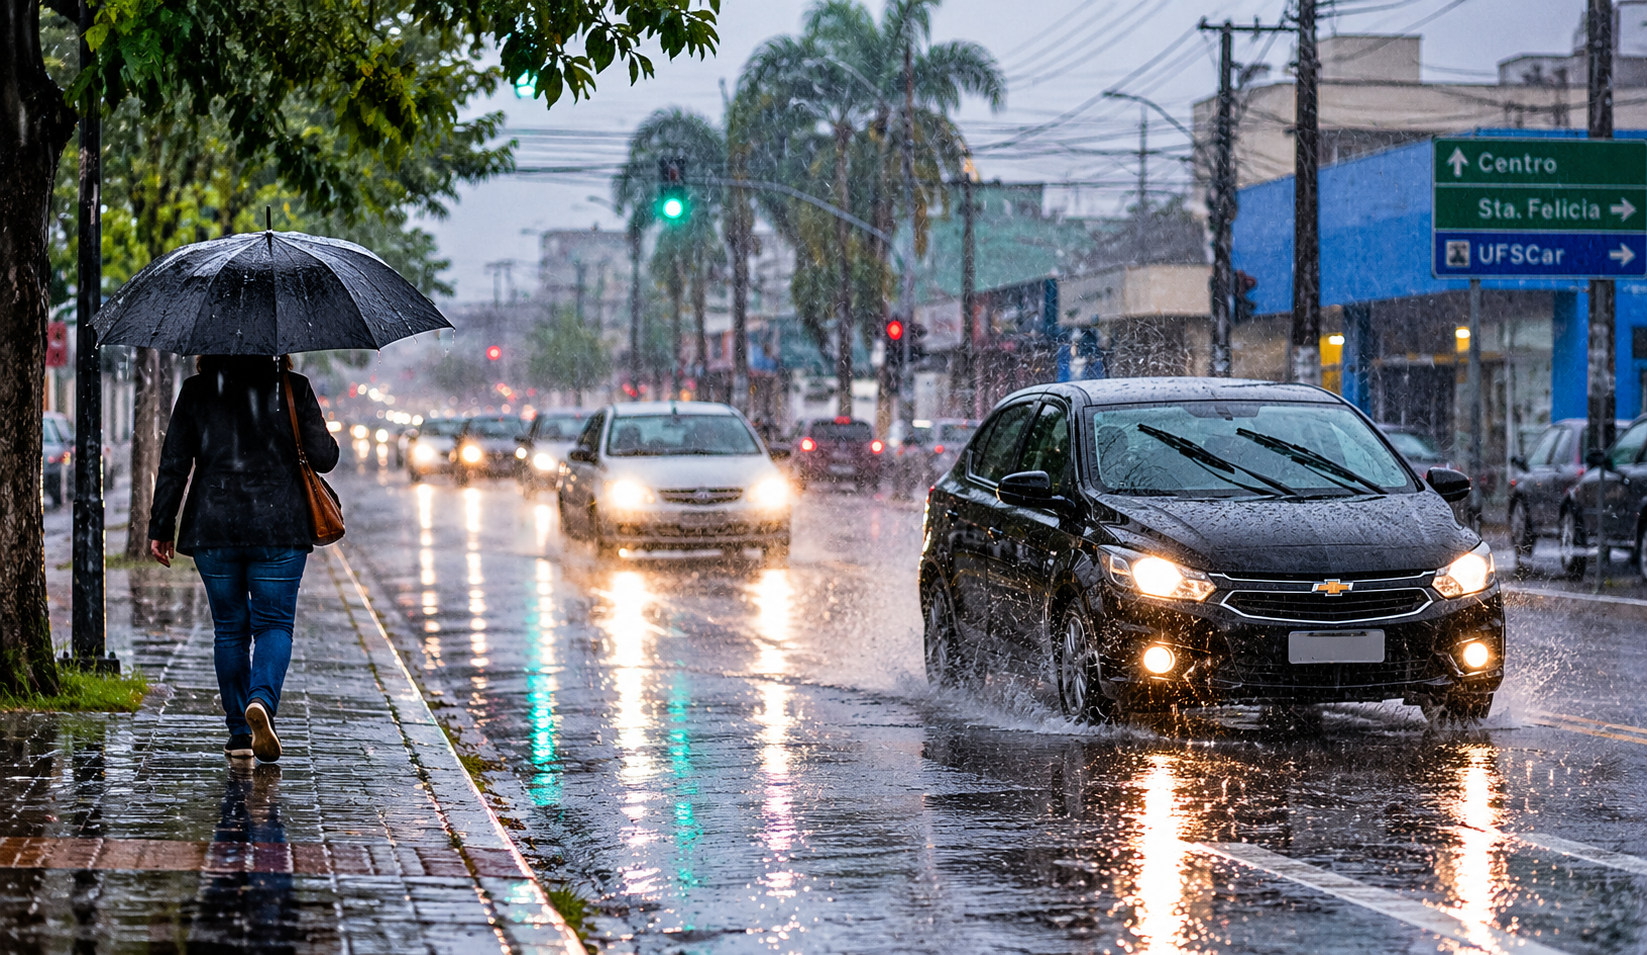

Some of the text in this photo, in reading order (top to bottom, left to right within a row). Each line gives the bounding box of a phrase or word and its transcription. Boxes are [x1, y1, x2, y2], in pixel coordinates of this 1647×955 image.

[1478, 152, 1557, 174] Centro
[1478, 198, 1601, 220] Sta. Felicia
[1479, 243, 1565, 265] UFSCar
